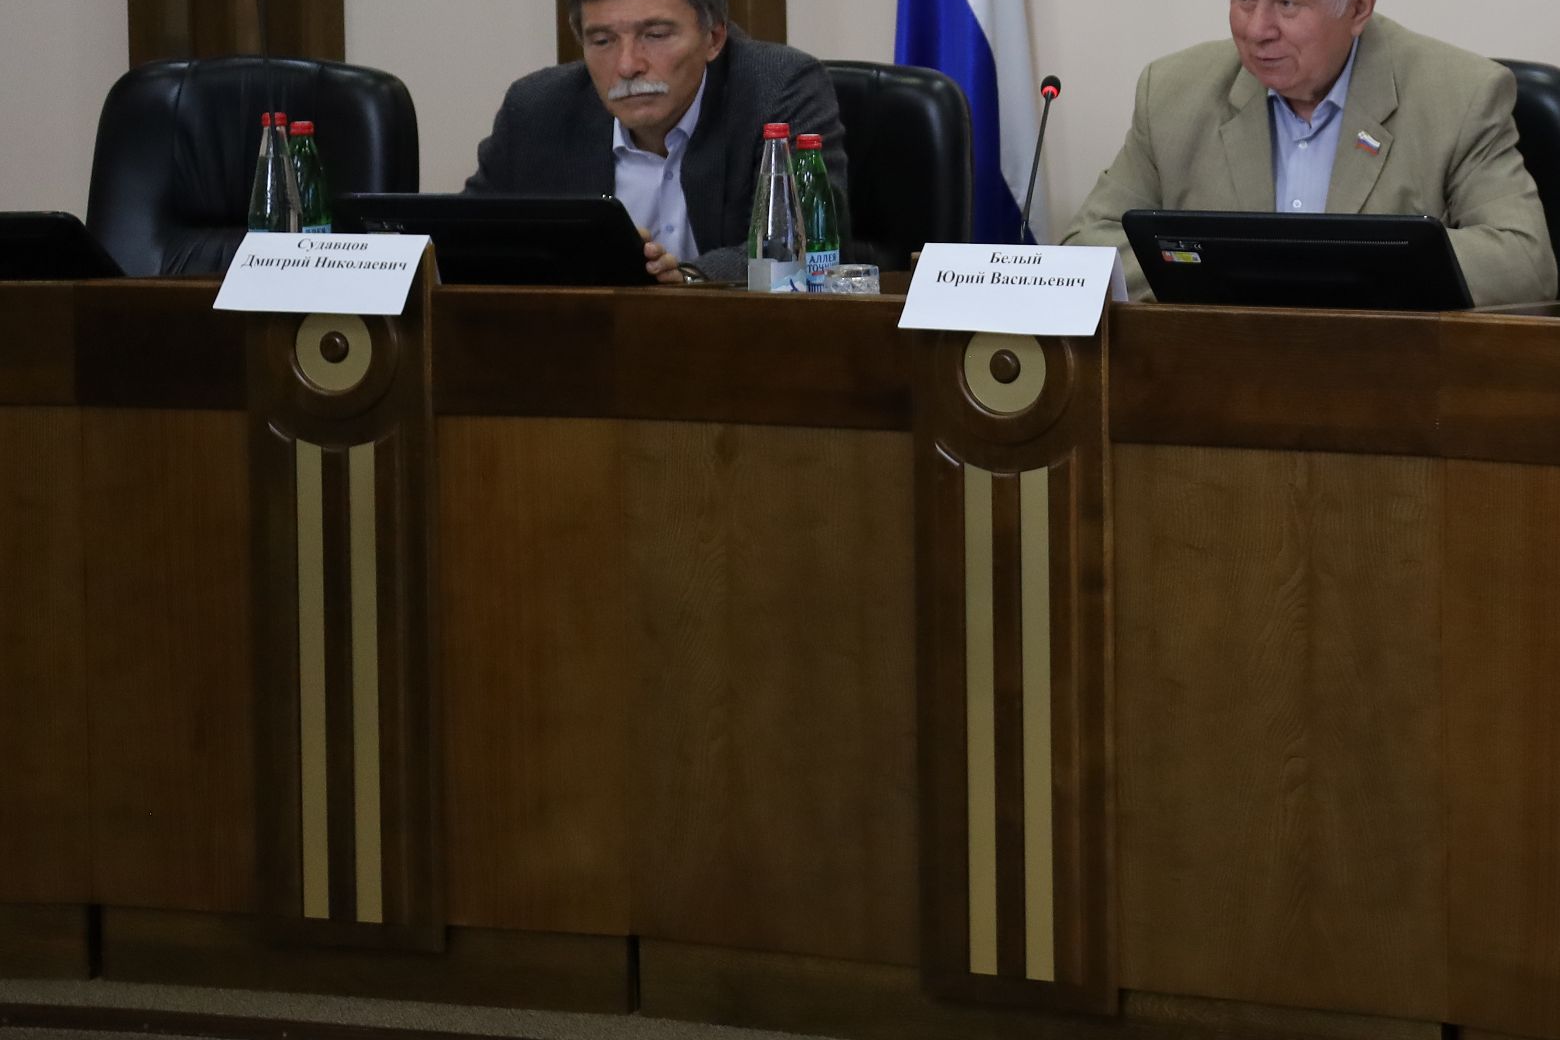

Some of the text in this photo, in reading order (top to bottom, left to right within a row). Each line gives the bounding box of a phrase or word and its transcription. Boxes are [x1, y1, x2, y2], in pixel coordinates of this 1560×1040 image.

[297, 237, 369, 252] Судавцов
[241, 254, 407, 271] Дмитрий Николаевич
[990, 252, 1043, 265] Белый
[935, 270, 1086, 288] Юрий Васильевич
